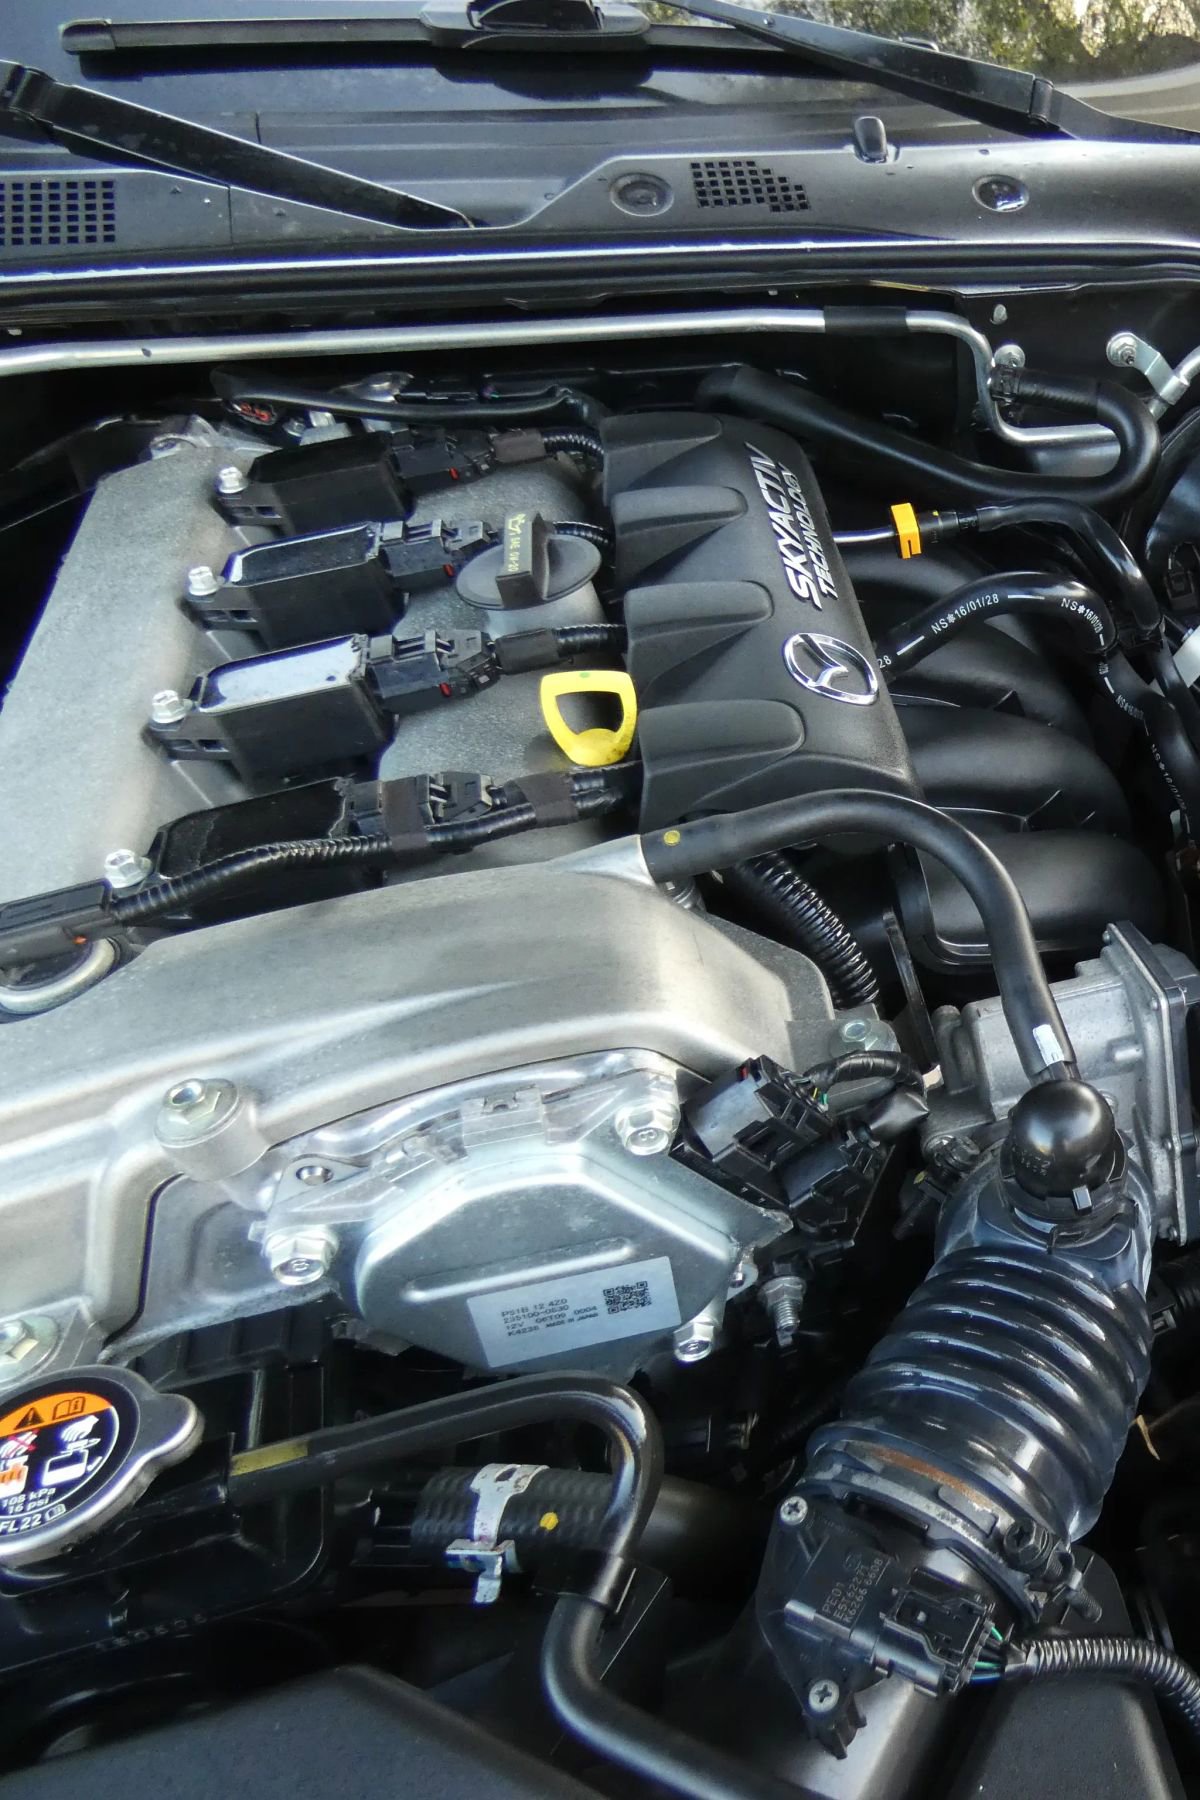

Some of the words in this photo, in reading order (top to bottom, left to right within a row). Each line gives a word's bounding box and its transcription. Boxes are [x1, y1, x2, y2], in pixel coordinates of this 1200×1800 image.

[744, 441, 822, 610] SKYACTIV
[778, 461, 838, 600] TECHNOLOGY
[545, 1319, 566, 1328] MADE
[577, 1312, 599, 1321] JAPAN
[2, 1494, 26, 1507] 108
[30, 1487, 56, 1500] kPa
[8, 1503, 24, 1514] 16
[26, 1496, 50, 1511] psi
[821, 1581, 846, 1614] PE01
